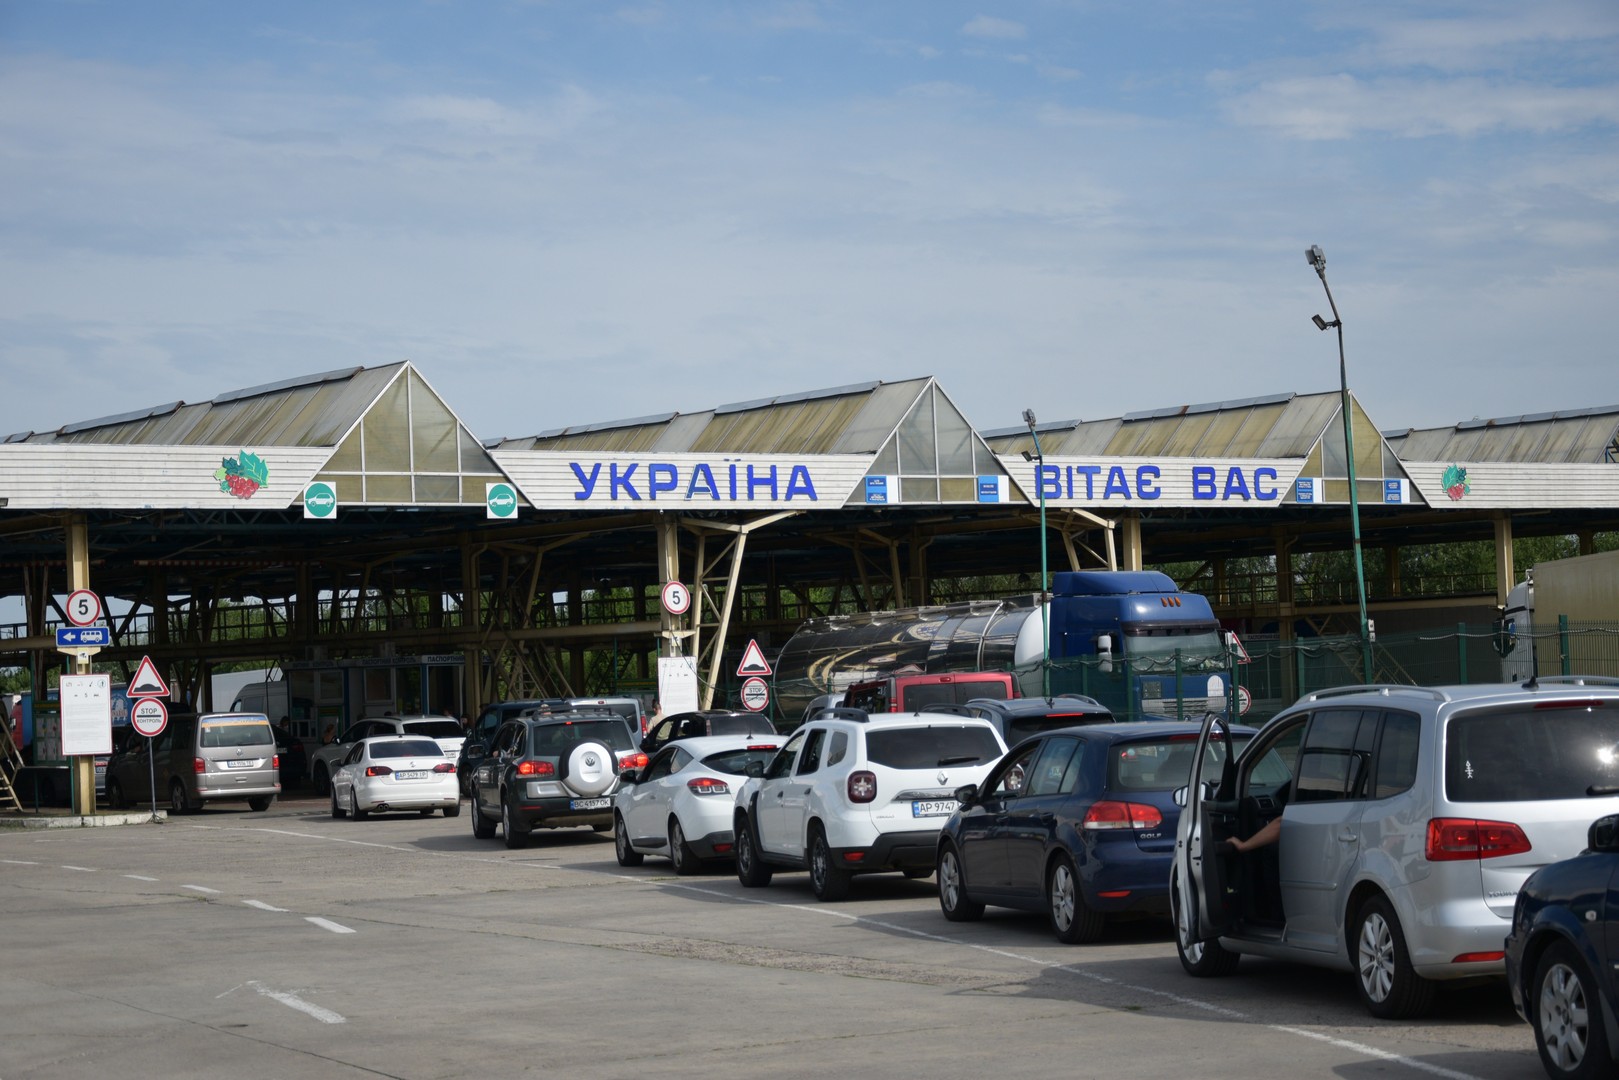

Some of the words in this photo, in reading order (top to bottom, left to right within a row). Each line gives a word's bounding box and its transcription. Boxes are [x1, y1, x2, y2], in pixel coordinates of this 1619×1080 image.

[569, 458, 818, 501] УКРАЇНА
[1034, 465, 1161, 500] ВІТАЄ
[1192, 466, 1278, 501] ВАС
[672, 591, 681, 605] 5
[78, 599, 88, 615] 5
[920, 803, 933, 812] AP
[934, 801, 955, 811] 9747
